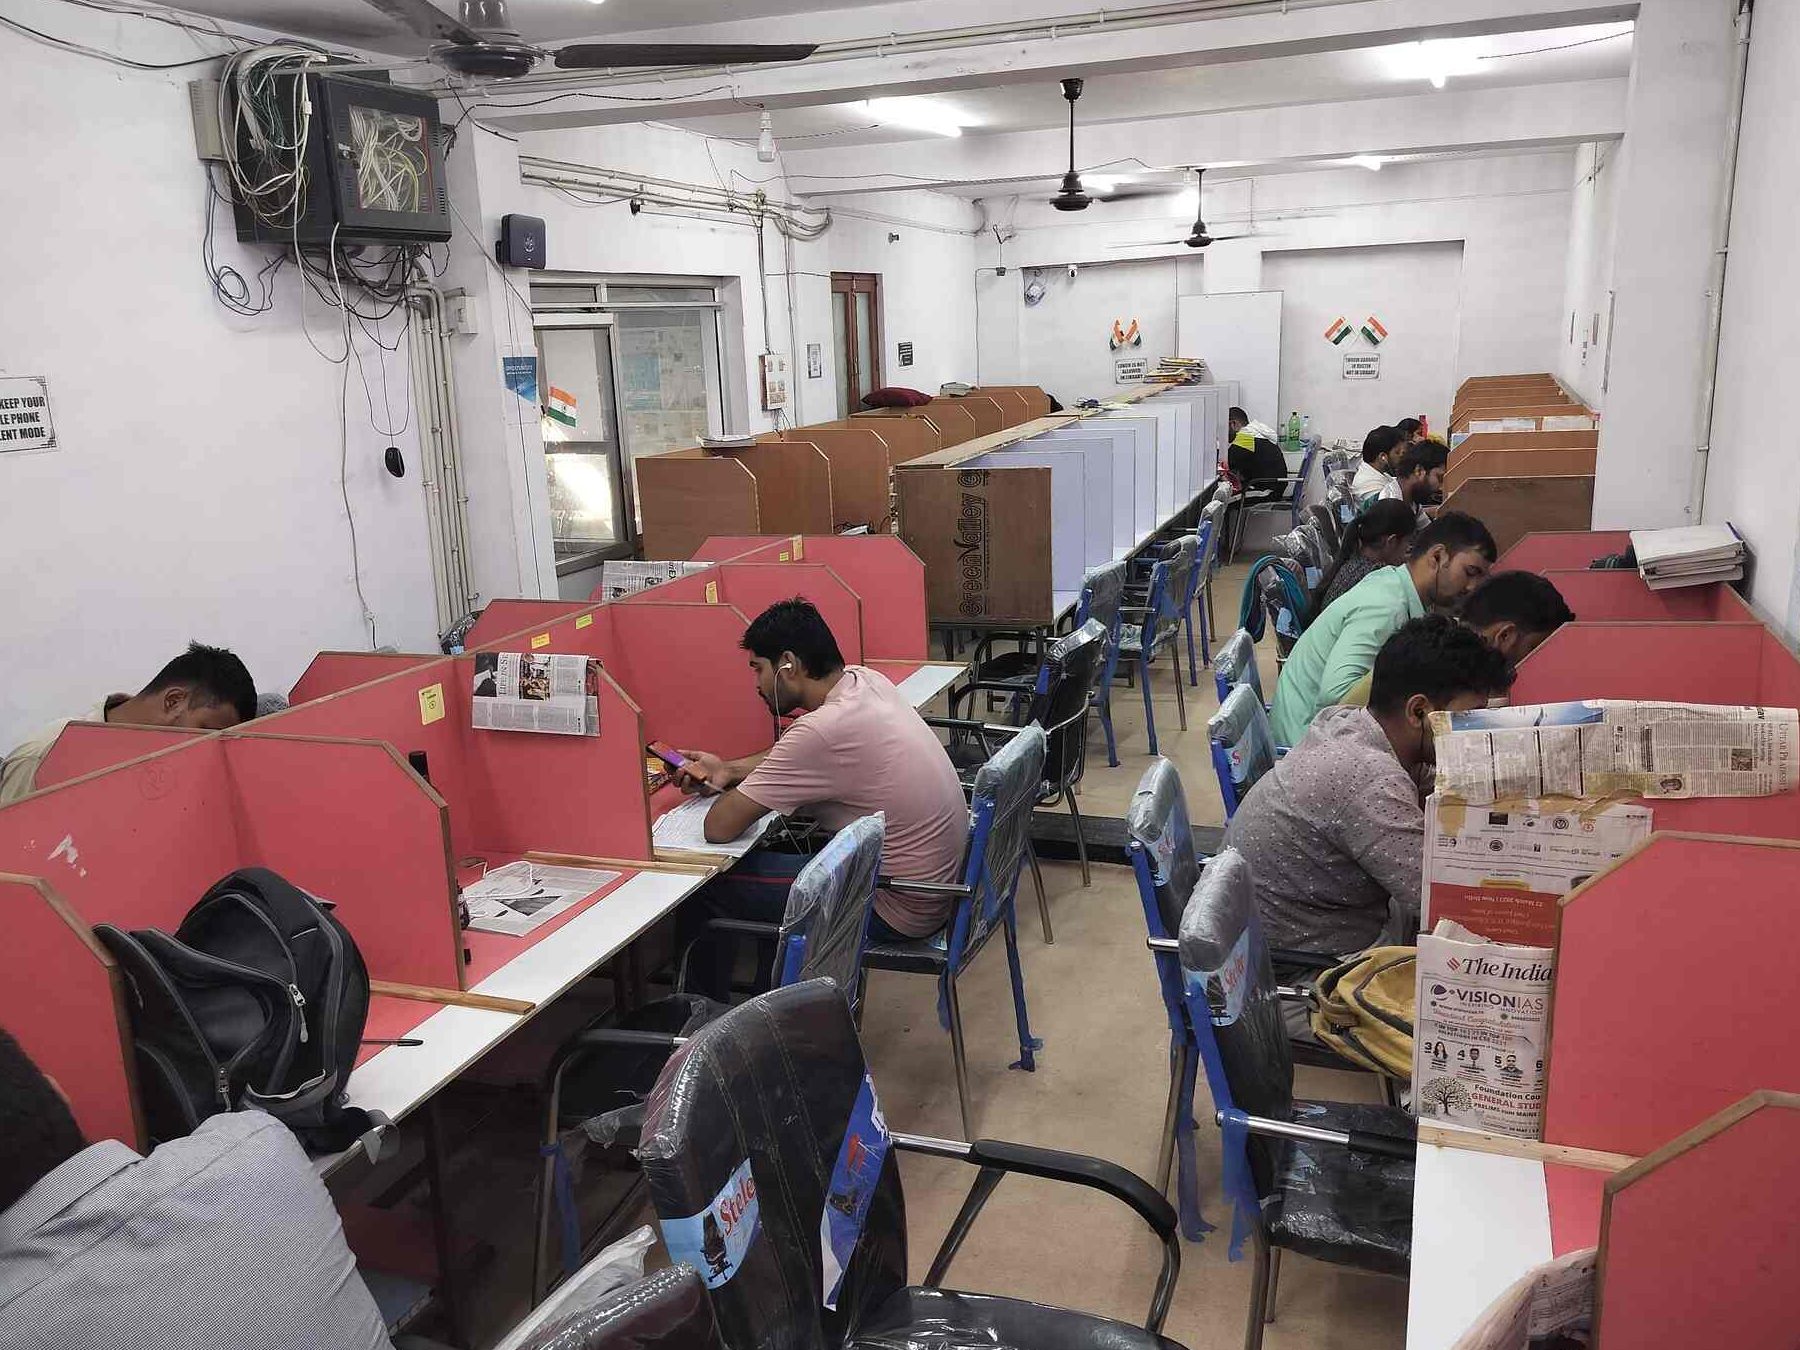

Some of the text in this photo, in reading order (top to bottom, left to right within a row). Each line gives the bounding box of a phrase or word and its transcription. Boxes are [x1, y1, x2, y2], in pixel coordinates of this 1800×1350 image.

[0, 396, 45, 409] KEEP YOUR
[11, 412, 40, 424] PHONE
[0, 427, 46, 440] ENT MODE
[1462, 958, 1499, 976] The
[1424, 1042, 1432, 1050] 3
[1495, 1056, 1502, 1064] 5
[1536, 1060, 1543, 1069] 6
[1474, 1084, 1523, 1100] Foundation
[1471, 1092, 1515, 1108] GENERAL
